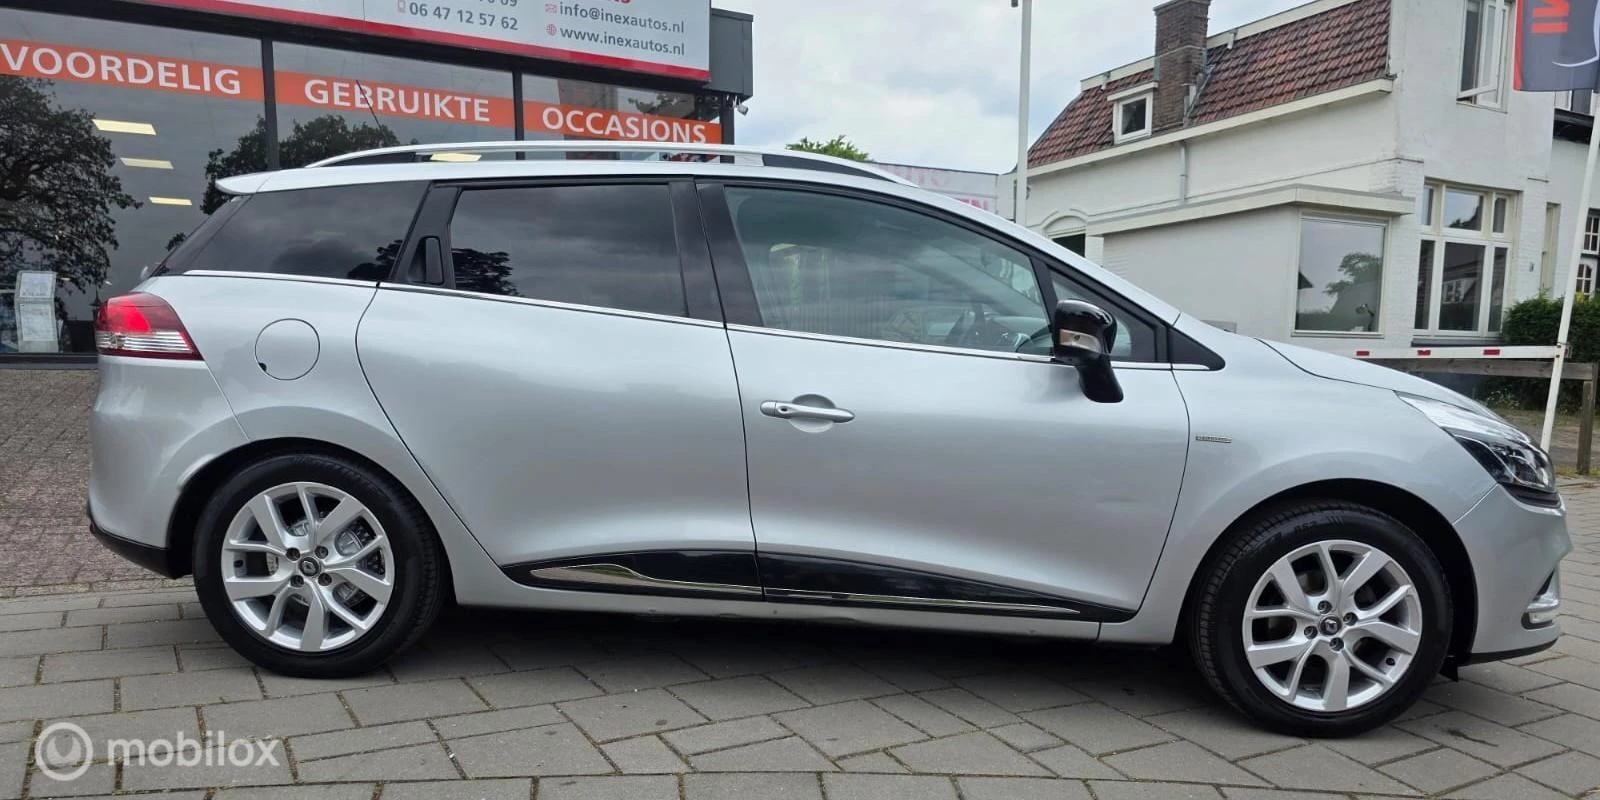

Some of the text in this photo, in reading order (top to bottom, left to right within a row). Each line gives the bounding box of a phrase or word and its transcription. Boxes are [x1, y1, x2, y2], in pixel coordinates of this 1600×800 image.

[409, 2, 519, 31] 06 47 12 57 62
[560, 2, 685, 33] info@inexautos.nl
[560, 27, 685, 56] www.inexautos.nl
[0, 44, 706, 143] VOORDELIG GEBRUIKTE OCCASIONS
